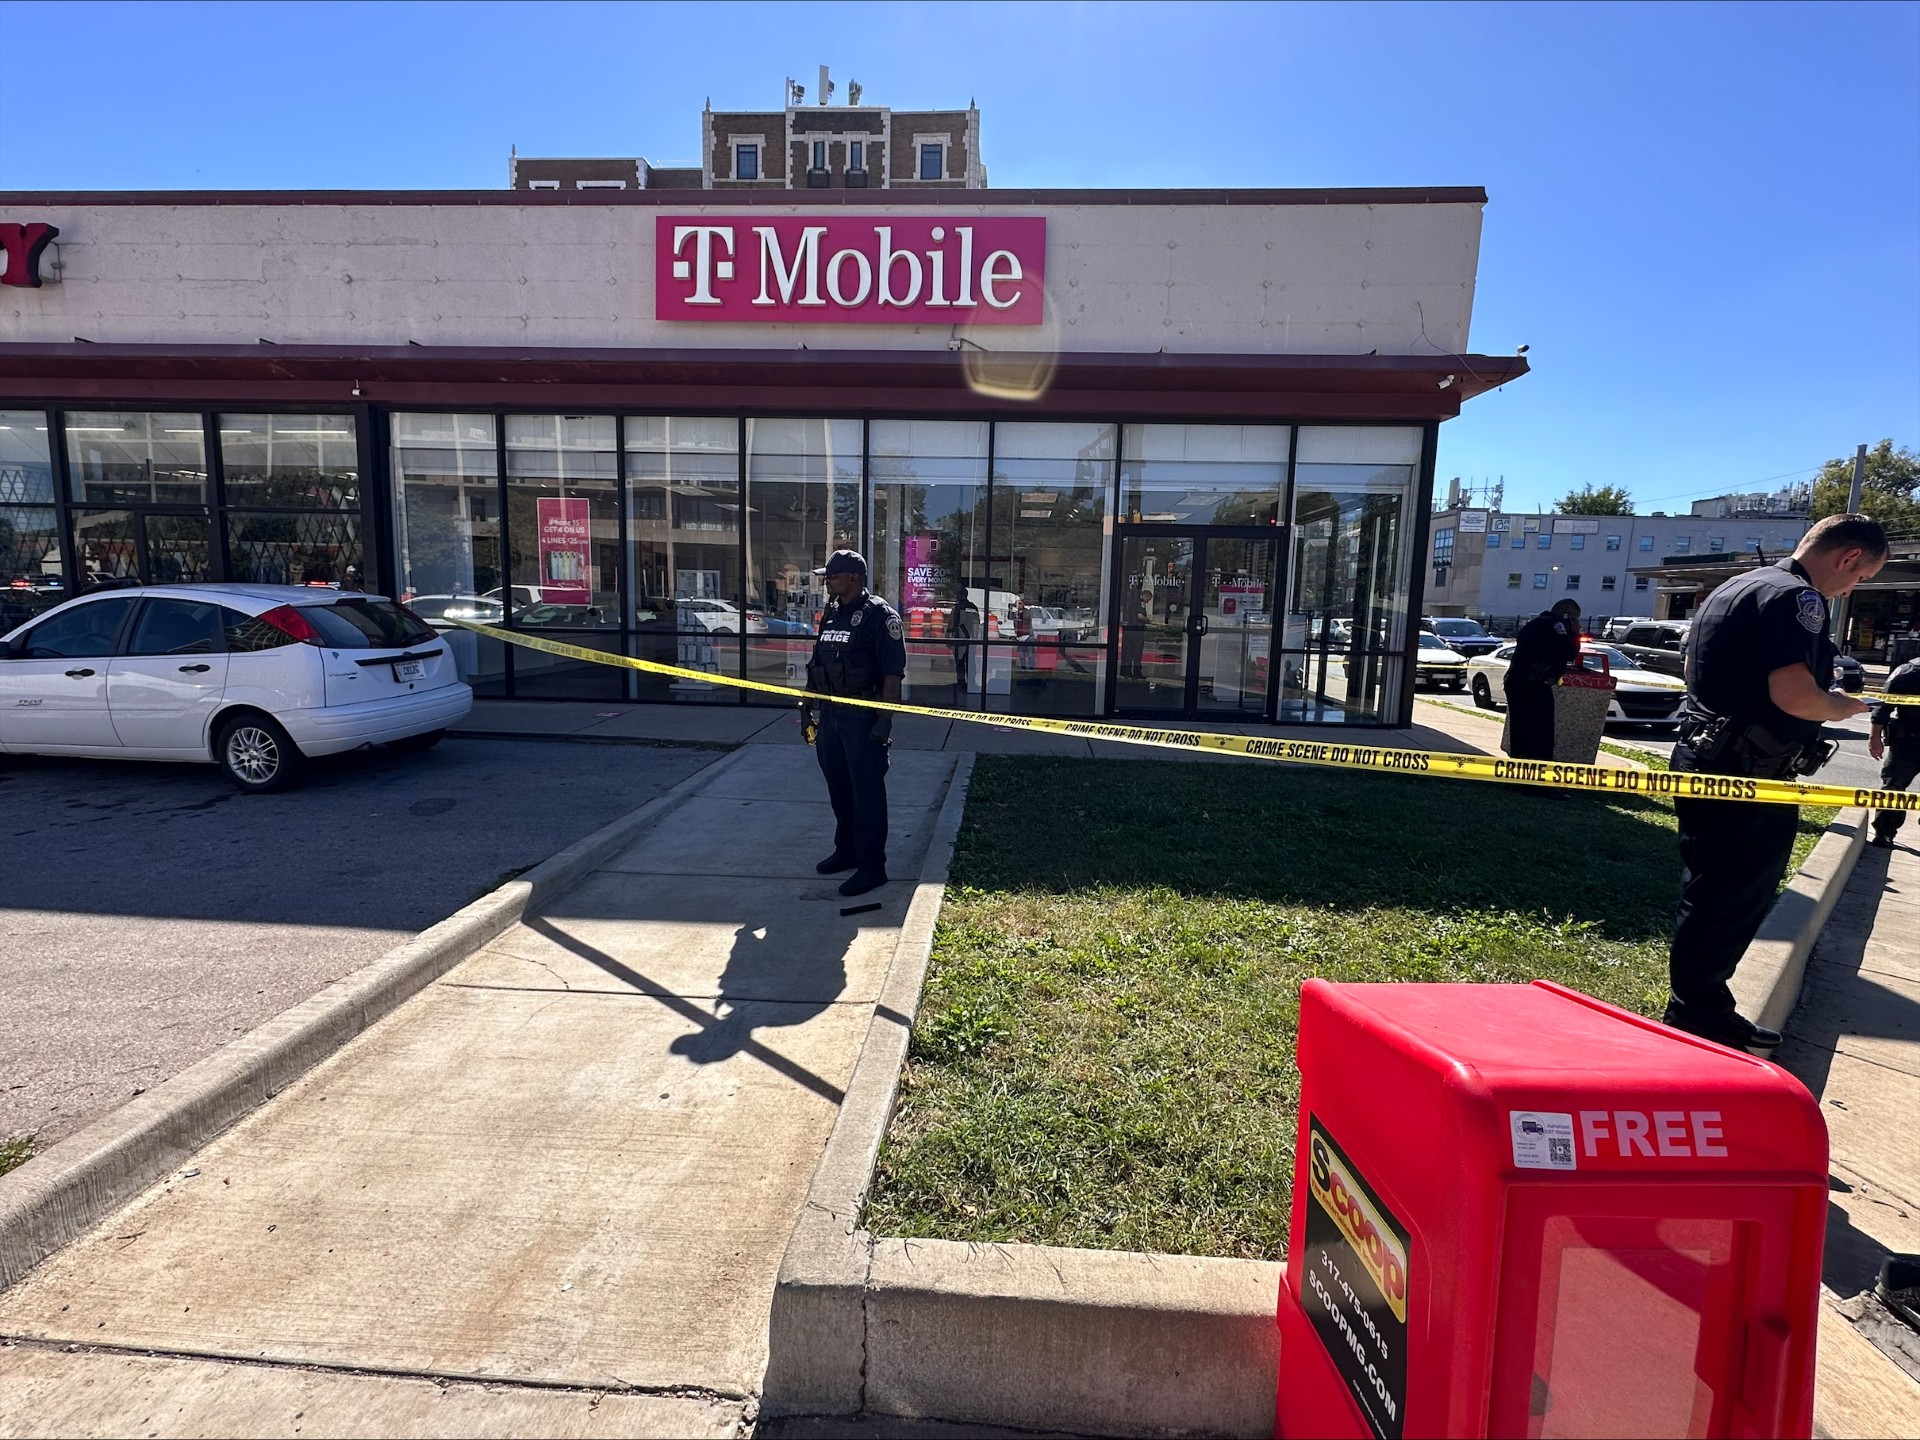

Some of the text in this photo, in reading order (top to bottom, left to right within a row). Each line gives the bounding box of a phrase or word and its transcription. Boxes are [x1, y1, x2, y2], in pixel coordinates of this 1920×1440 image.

[751, 226, 1024, 309] Mobile
[907, 567, 932, 577] SAVE
[1065, 723, 1201, 747] CRIME SCENE DO NOT CROSS
[1246, 739, 1430, 771] CRIME SCENE DO NOT CROSS
[1494, 760, 1757, 799] CRIME SCENE DO NOT CROSS
[1579, 1110, 1729, 1157] FREE
[1312, 1137, 1405, 1300] Scoop
[1321, 1250, 1388, 1360] 317-475-0615
[1308, 1269, 1397, 1422] SCOOPMG.COM
